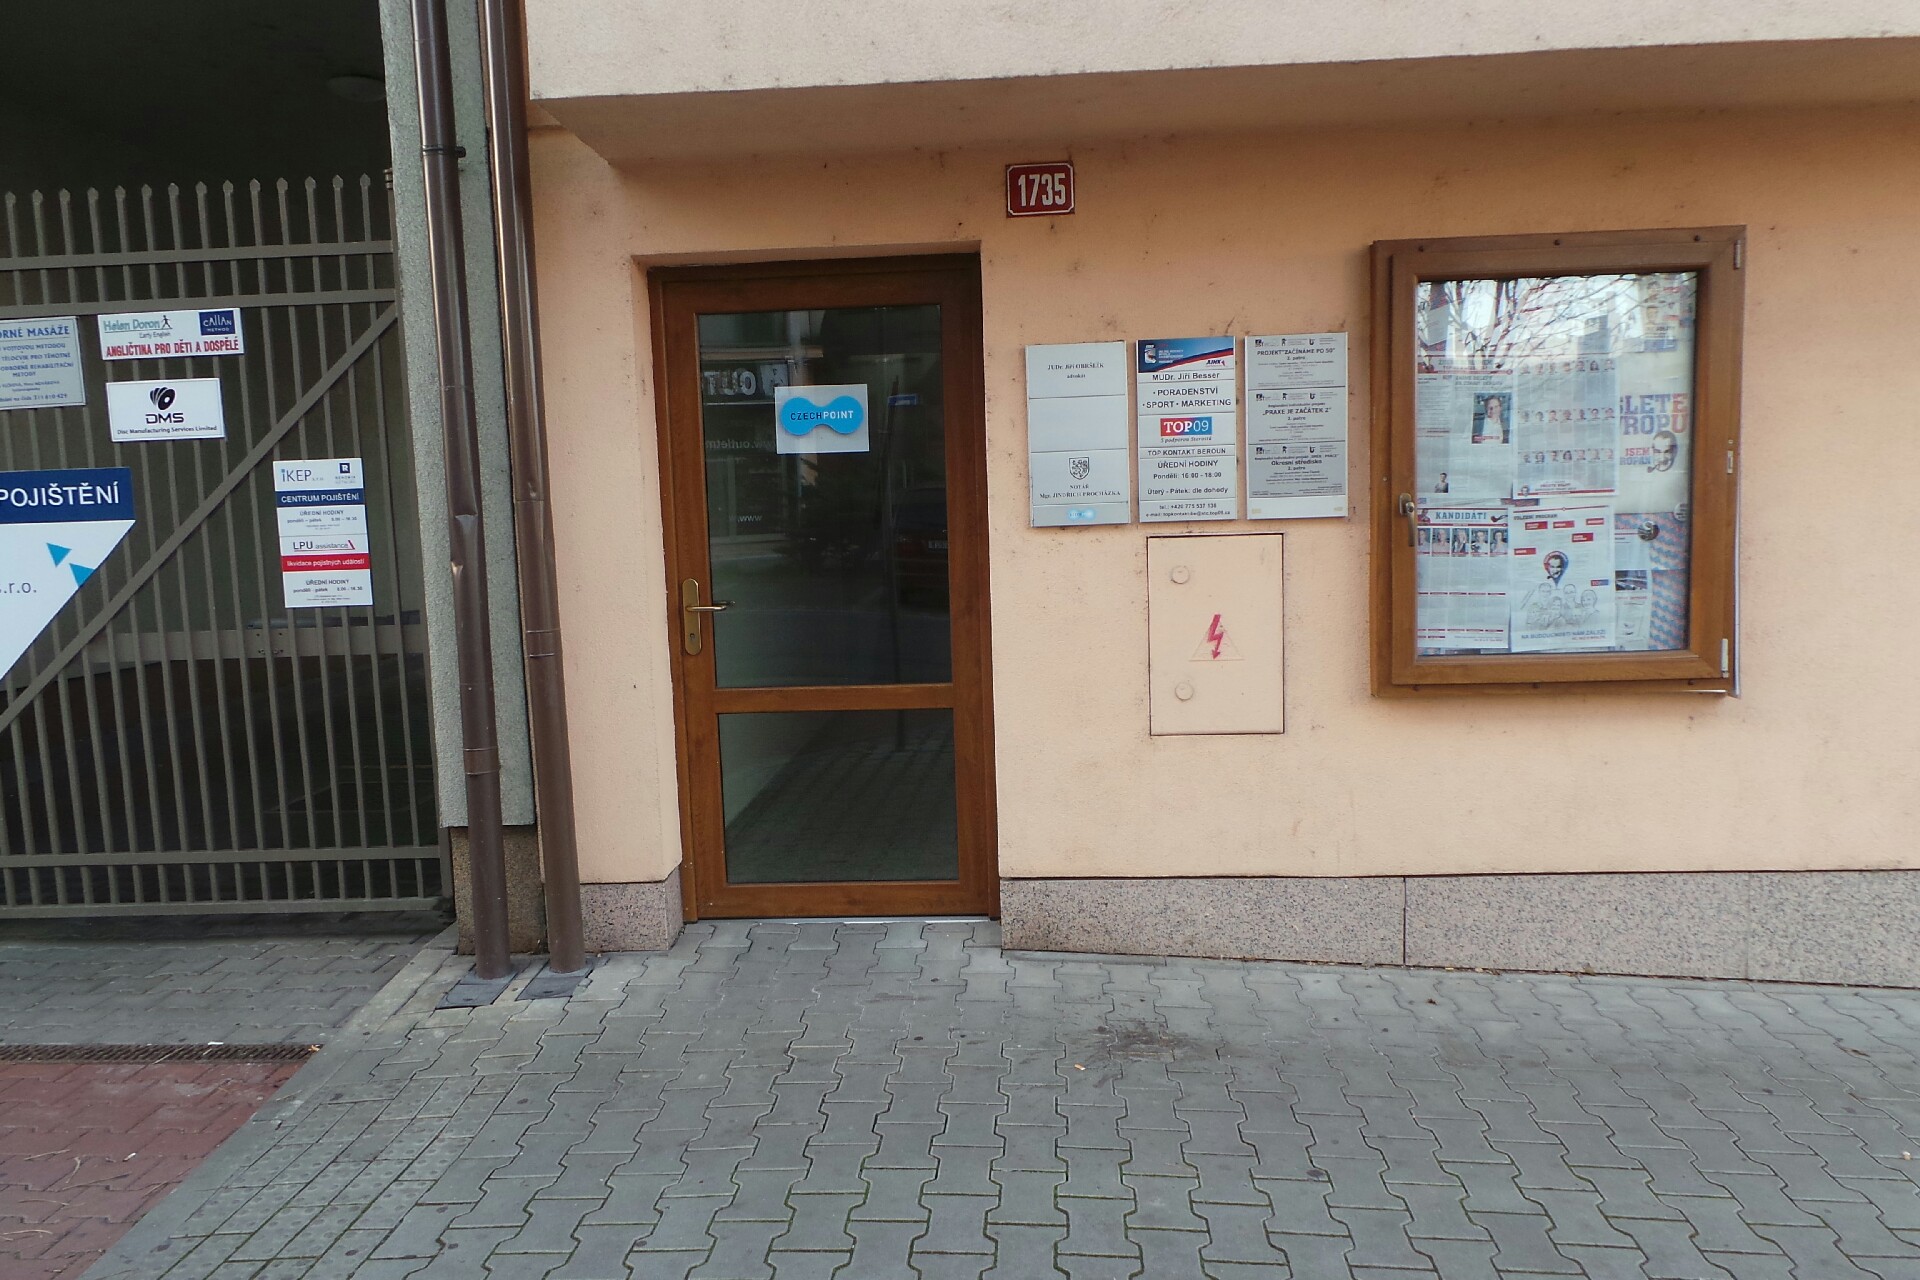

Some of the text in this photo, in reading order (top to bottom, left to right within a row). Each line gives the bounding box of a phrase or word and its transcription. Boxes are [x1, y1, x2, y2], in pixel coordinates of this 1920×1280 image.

[1018, 172, 1066, 207] 1735
[104, 317, 160, 331] Helen Doron
[27, 324, 71, 337] MASÁŽE
[106, 336, 239, 357] ANGLIČTINA PRO DĚTI A DOSPĚLÉ
[1157, 387, 1218, 398] PORADENSTVÍ
[1146, 398, 1232, 409] SPORT MARKETING
[1295, 406, 1323, 414] ZAČÁTEK
[145, 413, 184, 424] DMS
[130, 426, 171, 435] Manufacturing
[196, 424, 217, 432] Limited
[1163, 420, 1209, 433] TOP09
[1620, 414, 1688, 435] ROPU
[1157, 460, 1219, 469] ÚŘEDNÍ HODINY
[1147, 488, 1164, 496] Úterý
[281, 493, 360, 503] CENTRUM POJIŠTĚNÍ
[293, 541, 313, 549] LPU
[0, 582, 37, 594] .r.o.
